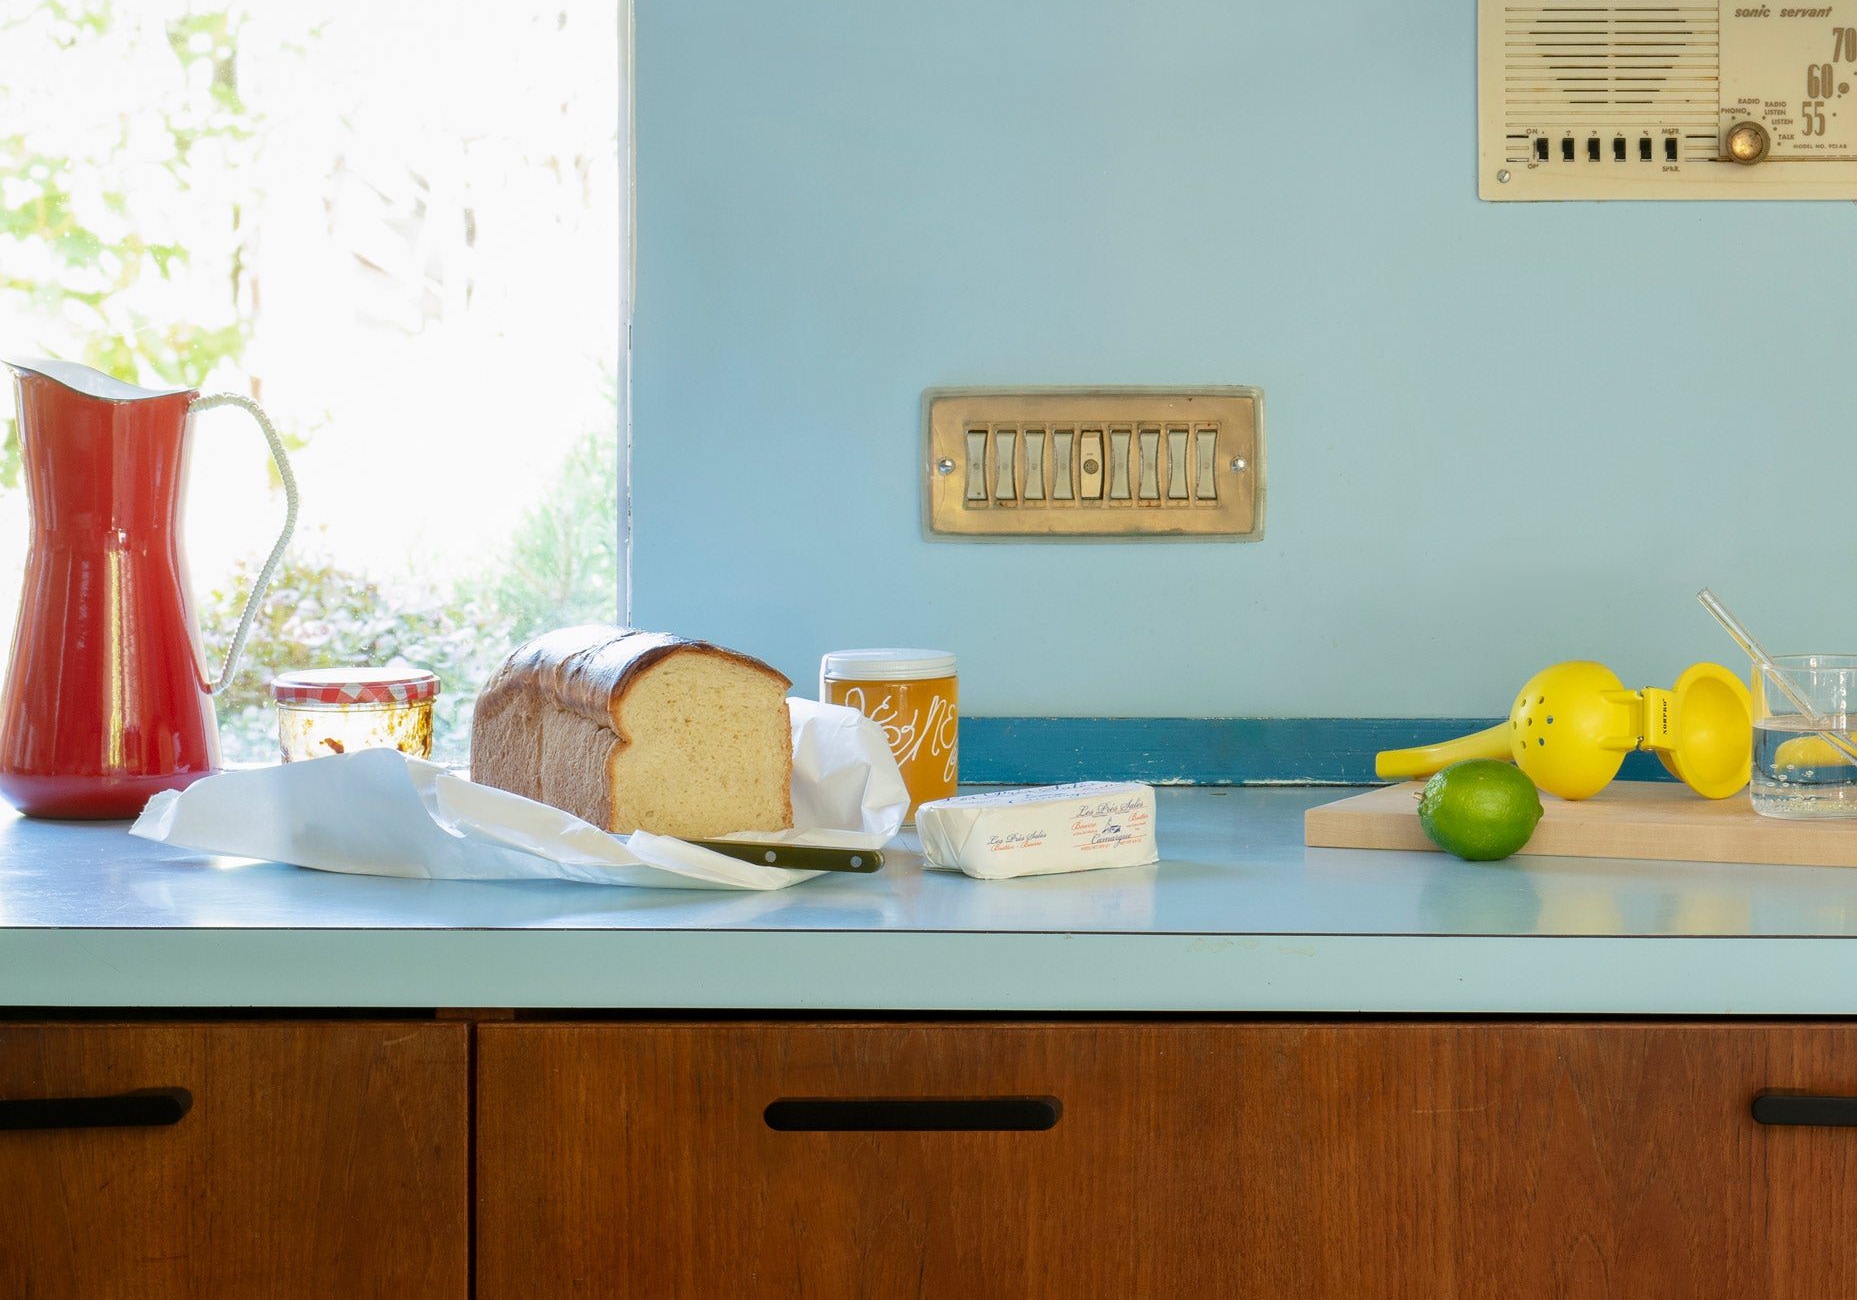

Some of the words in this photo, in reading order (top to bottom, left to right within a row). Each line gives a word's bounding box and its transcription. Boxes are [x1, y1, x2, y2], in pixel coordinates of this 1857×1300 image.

[1734, 4, 1771, 18] sonic
[1779, 6, 1833, 18] servant
[1832, 27, 1857, 63] 70
[1807, 63, 1834, 99] 60
[1801, 101, 1826, 137] 55
[1778, 133, 1795, 141] TALK
[1076, 804, 1094, 818] Les
[986, 835, 1003, 845] Les
